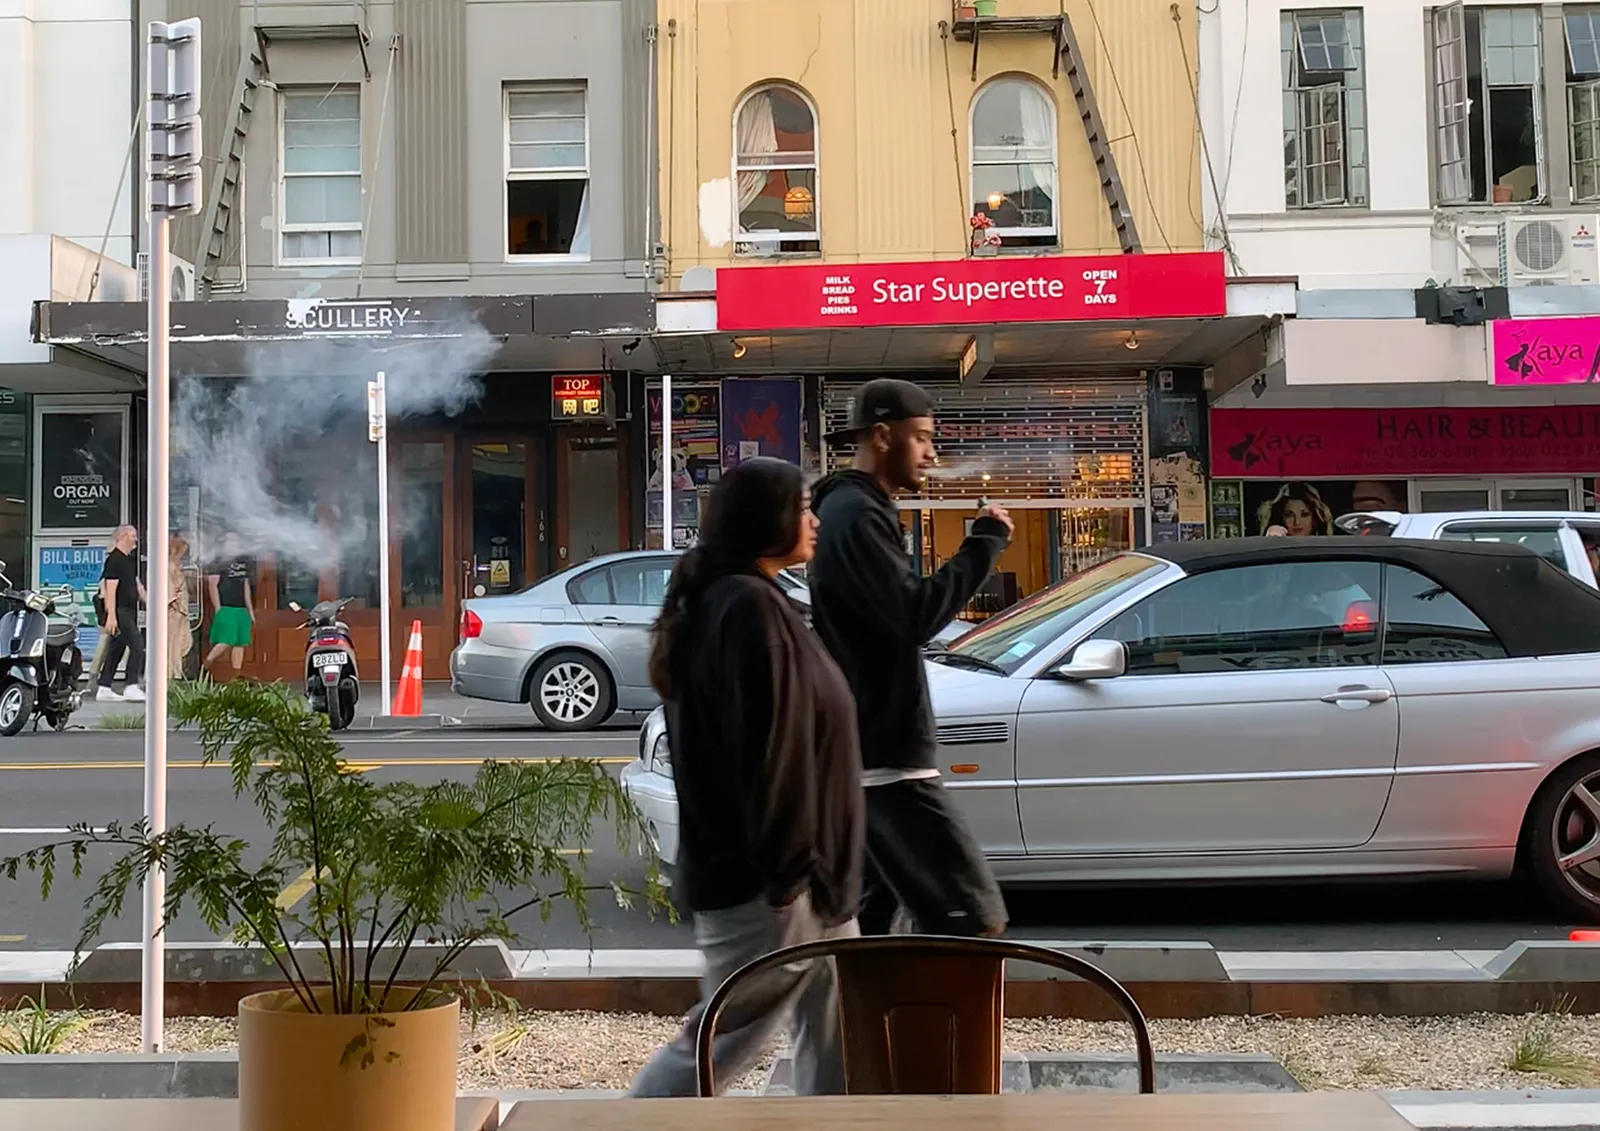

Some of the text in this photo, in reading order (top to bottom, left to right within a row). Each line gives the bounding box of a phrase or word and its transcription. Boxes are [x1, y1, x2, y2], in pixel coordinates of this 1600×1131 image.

[825, 276, 851, 284] MILK
[1082, 270, 1118, 280] OPEN
[822, 286, 856, 295] BREAD
[872, 276, 1064, 306] Star Superette
[1093, 279, 1107, 294] 7
[827, 296, 851, 305] PIES
[1084, 294, 1117, 304] DAYS
[820, 305, 858, 315] DRINKS
[1505, 334, 1584, 378] Kaya
[563, 379, 590, 390] TOP
[1377, 415, 1456, 440] HAIR
[1468, 417, 1494, 439] &
[53, 485, 110, 498] ORGAN
[43, 551, 70, 564] BILL
